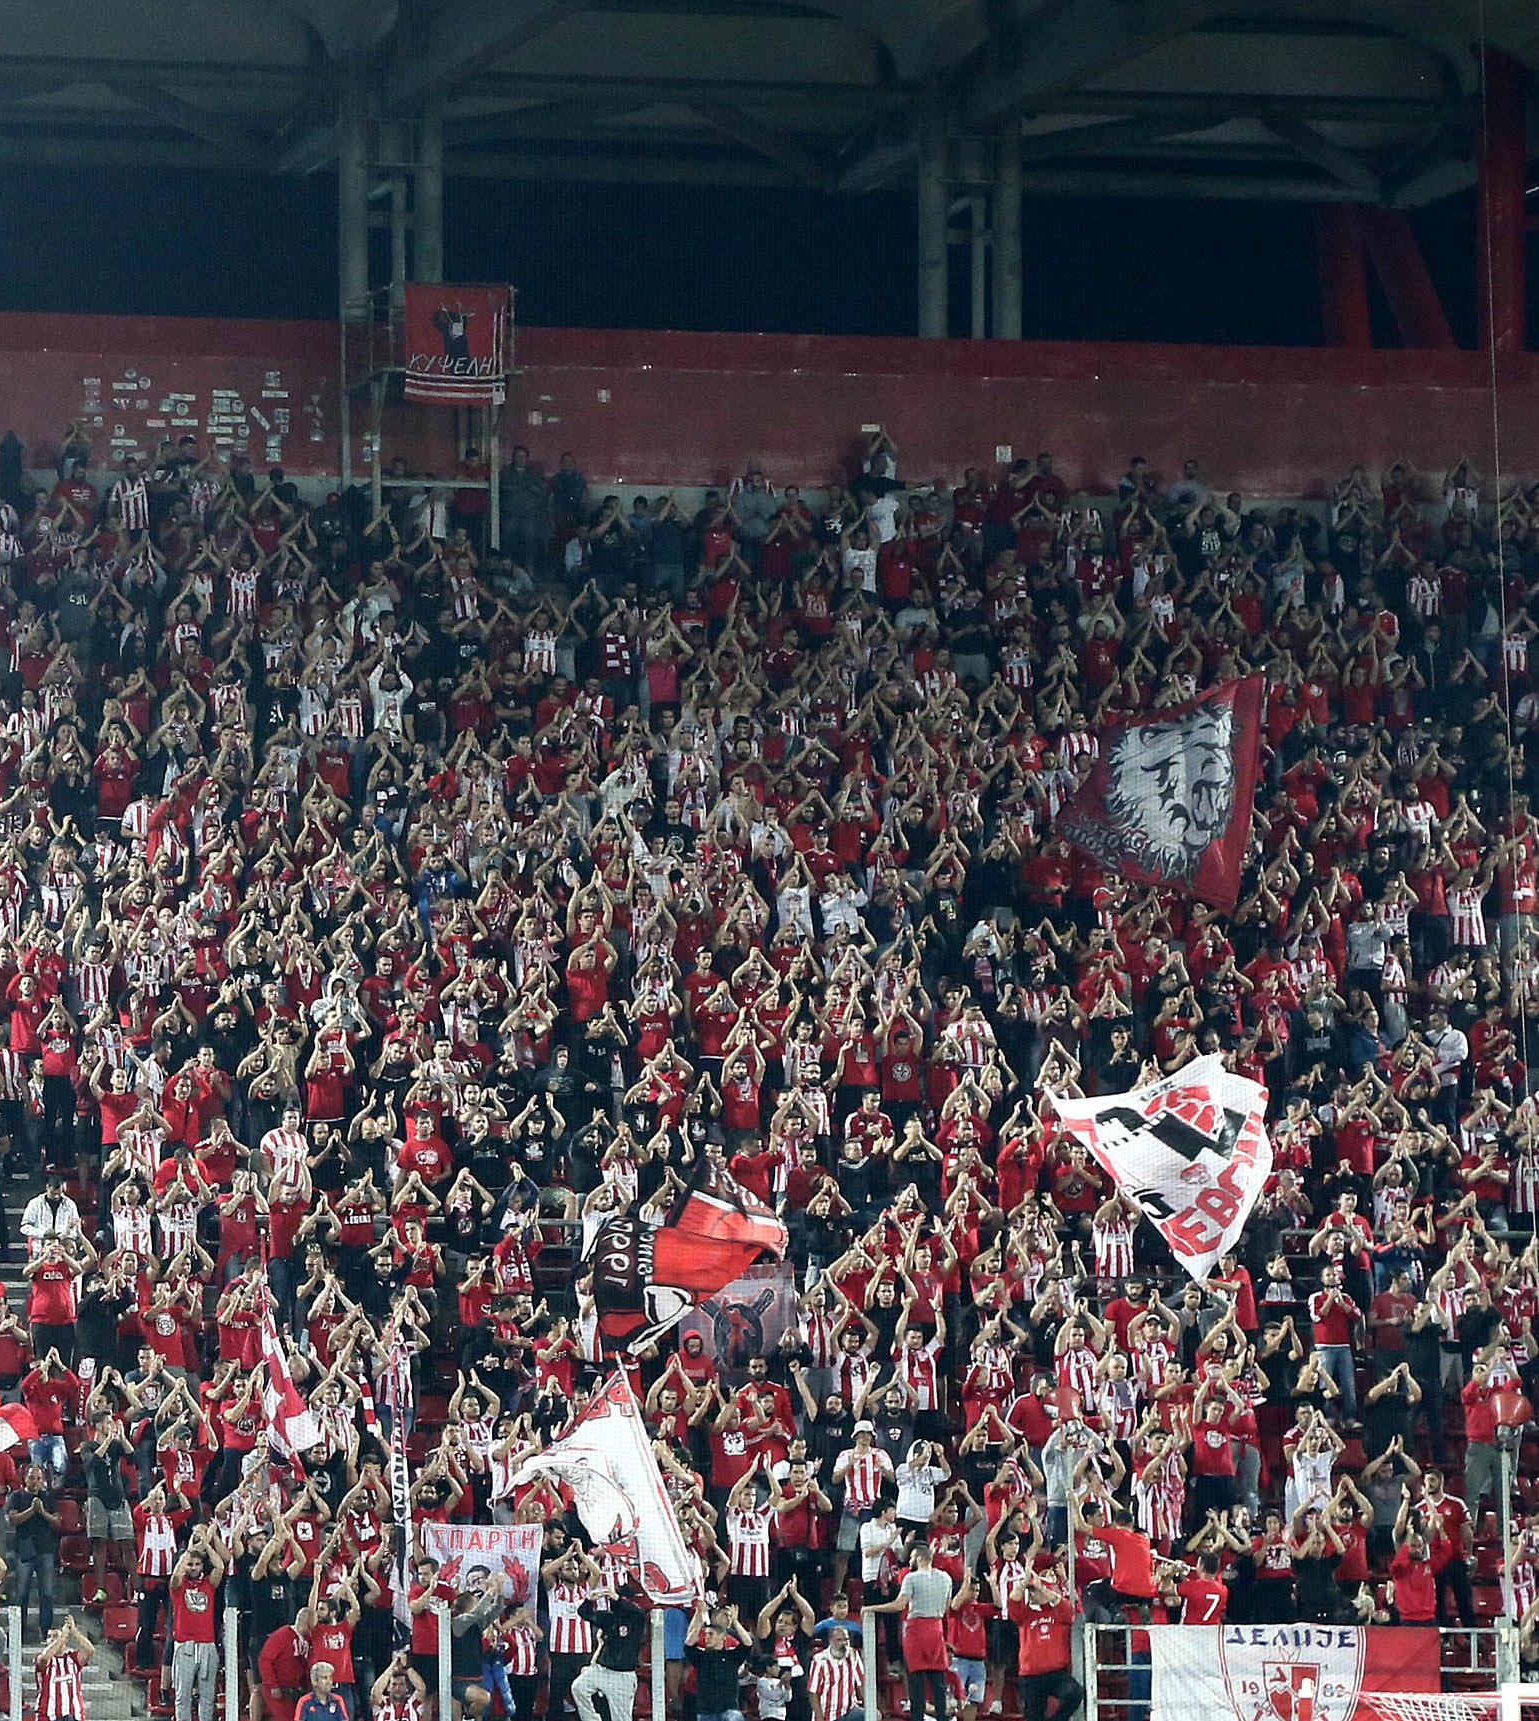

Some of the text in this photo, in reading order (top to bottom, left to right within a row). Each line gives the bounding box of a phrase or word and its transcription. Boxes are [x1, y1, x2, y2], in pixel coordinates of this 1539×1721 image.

[408, 353, 493, 376] ΚΥΨΕΛΗ
[433, 1529, 536, 1551] ΣΠΑΡΤΗ
[1204, 1593, 1220, 1622] 7
[1241, 1680, 1260, 1695] 19
